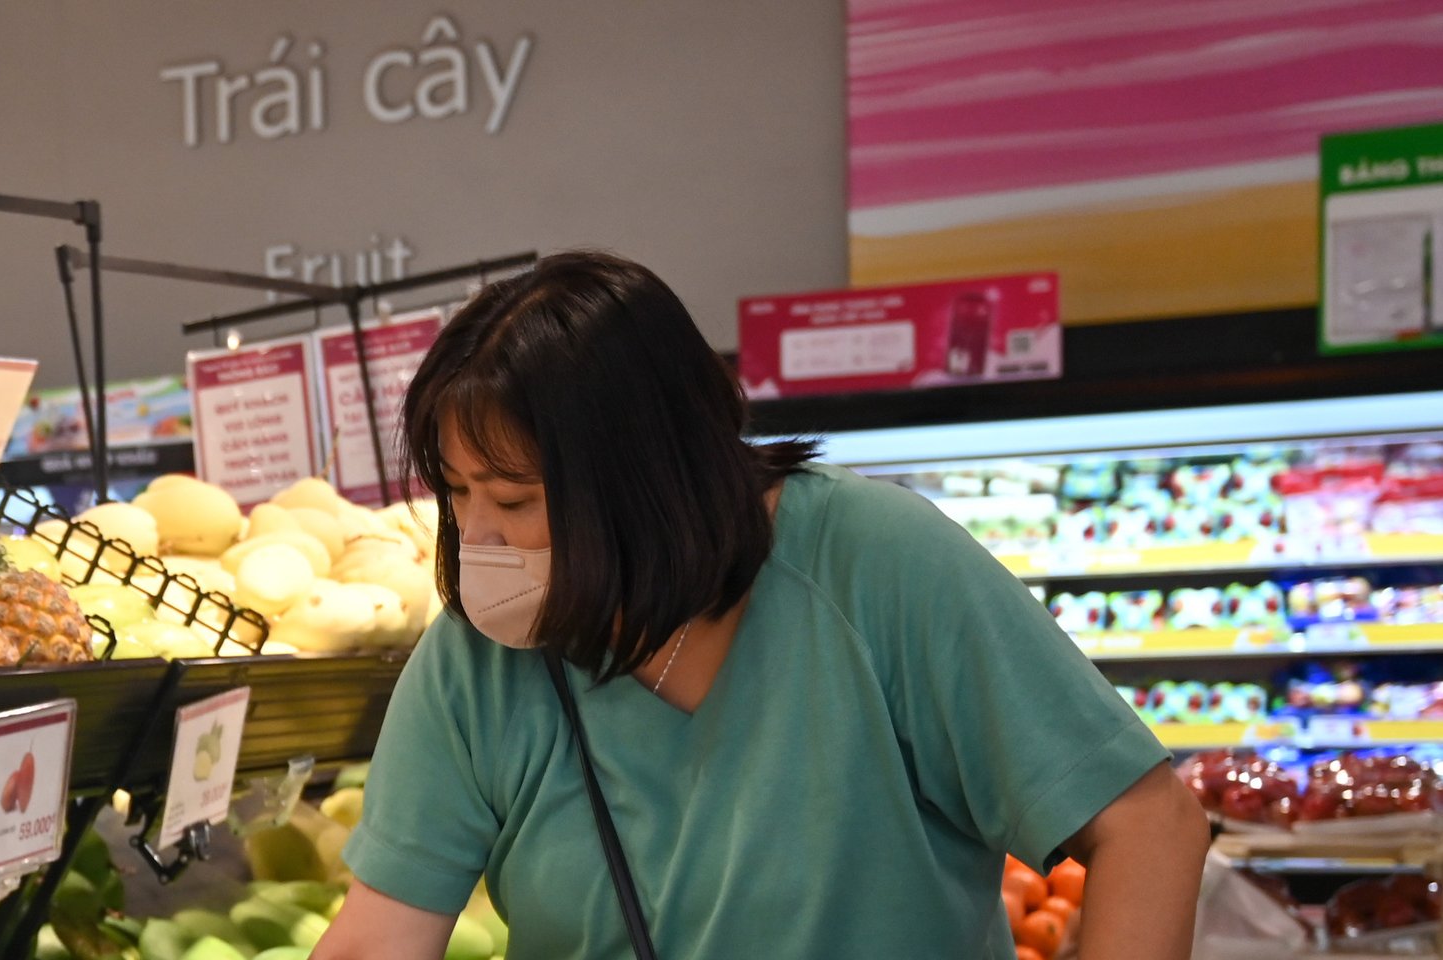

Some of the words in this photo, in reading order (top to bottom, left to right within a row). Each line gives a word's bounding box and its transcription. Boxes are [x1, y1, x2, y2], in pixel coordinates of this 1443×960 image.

[159, 34, 327, 148] Trái
[363, 15, 533, 135] cây
[264, 235, 414, 302] Fruit
